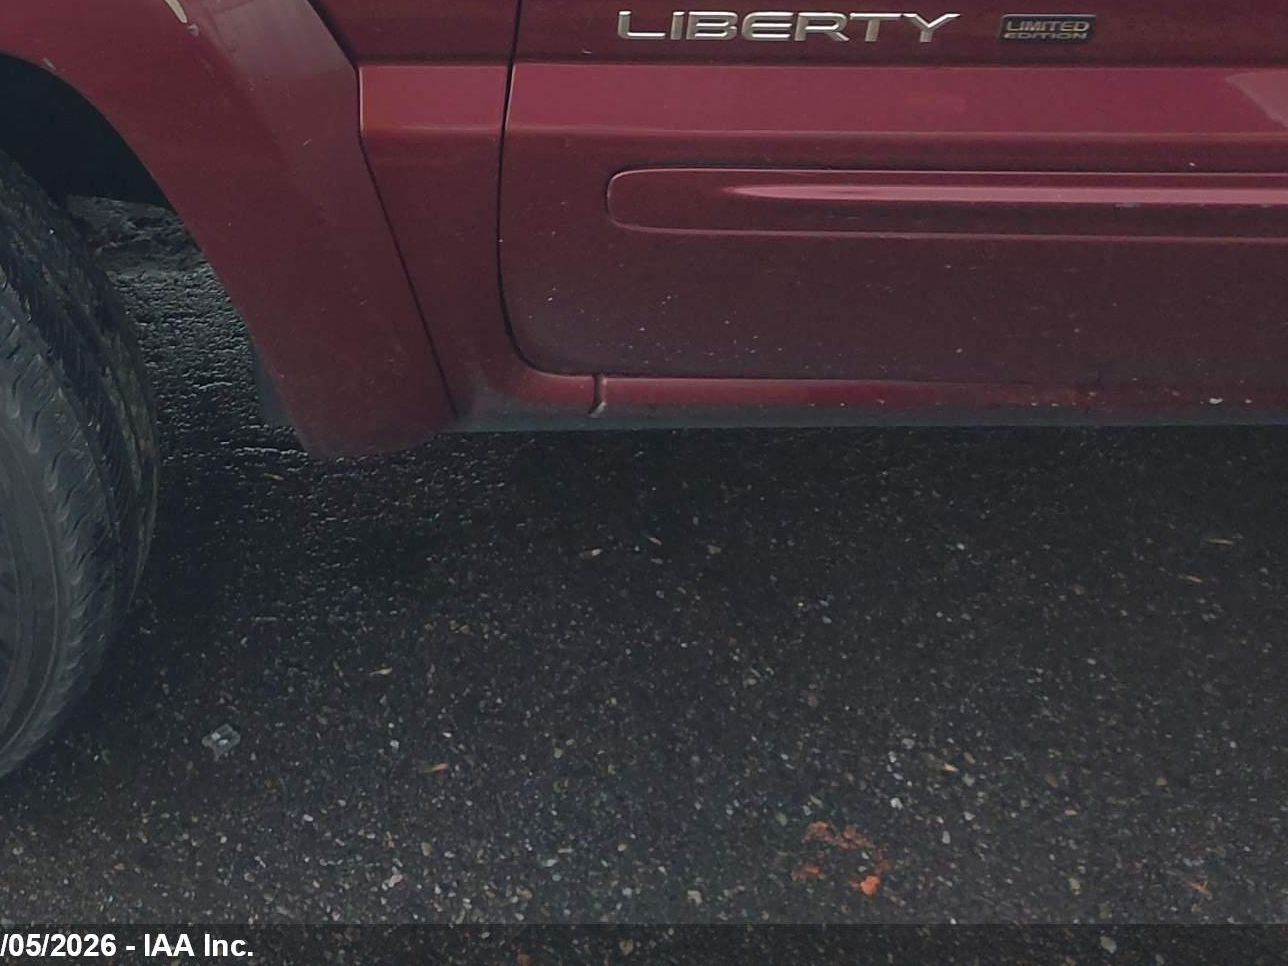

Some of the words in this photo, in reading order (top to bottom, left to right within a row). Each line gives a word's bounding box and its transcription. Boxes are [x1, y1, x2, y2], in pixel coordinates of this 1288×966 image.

[617, 10, 960, 43] LIBERTY
[1006, 20, 1090, 32] LIMITED
[1004, 32, 1088, 40] EDITION
